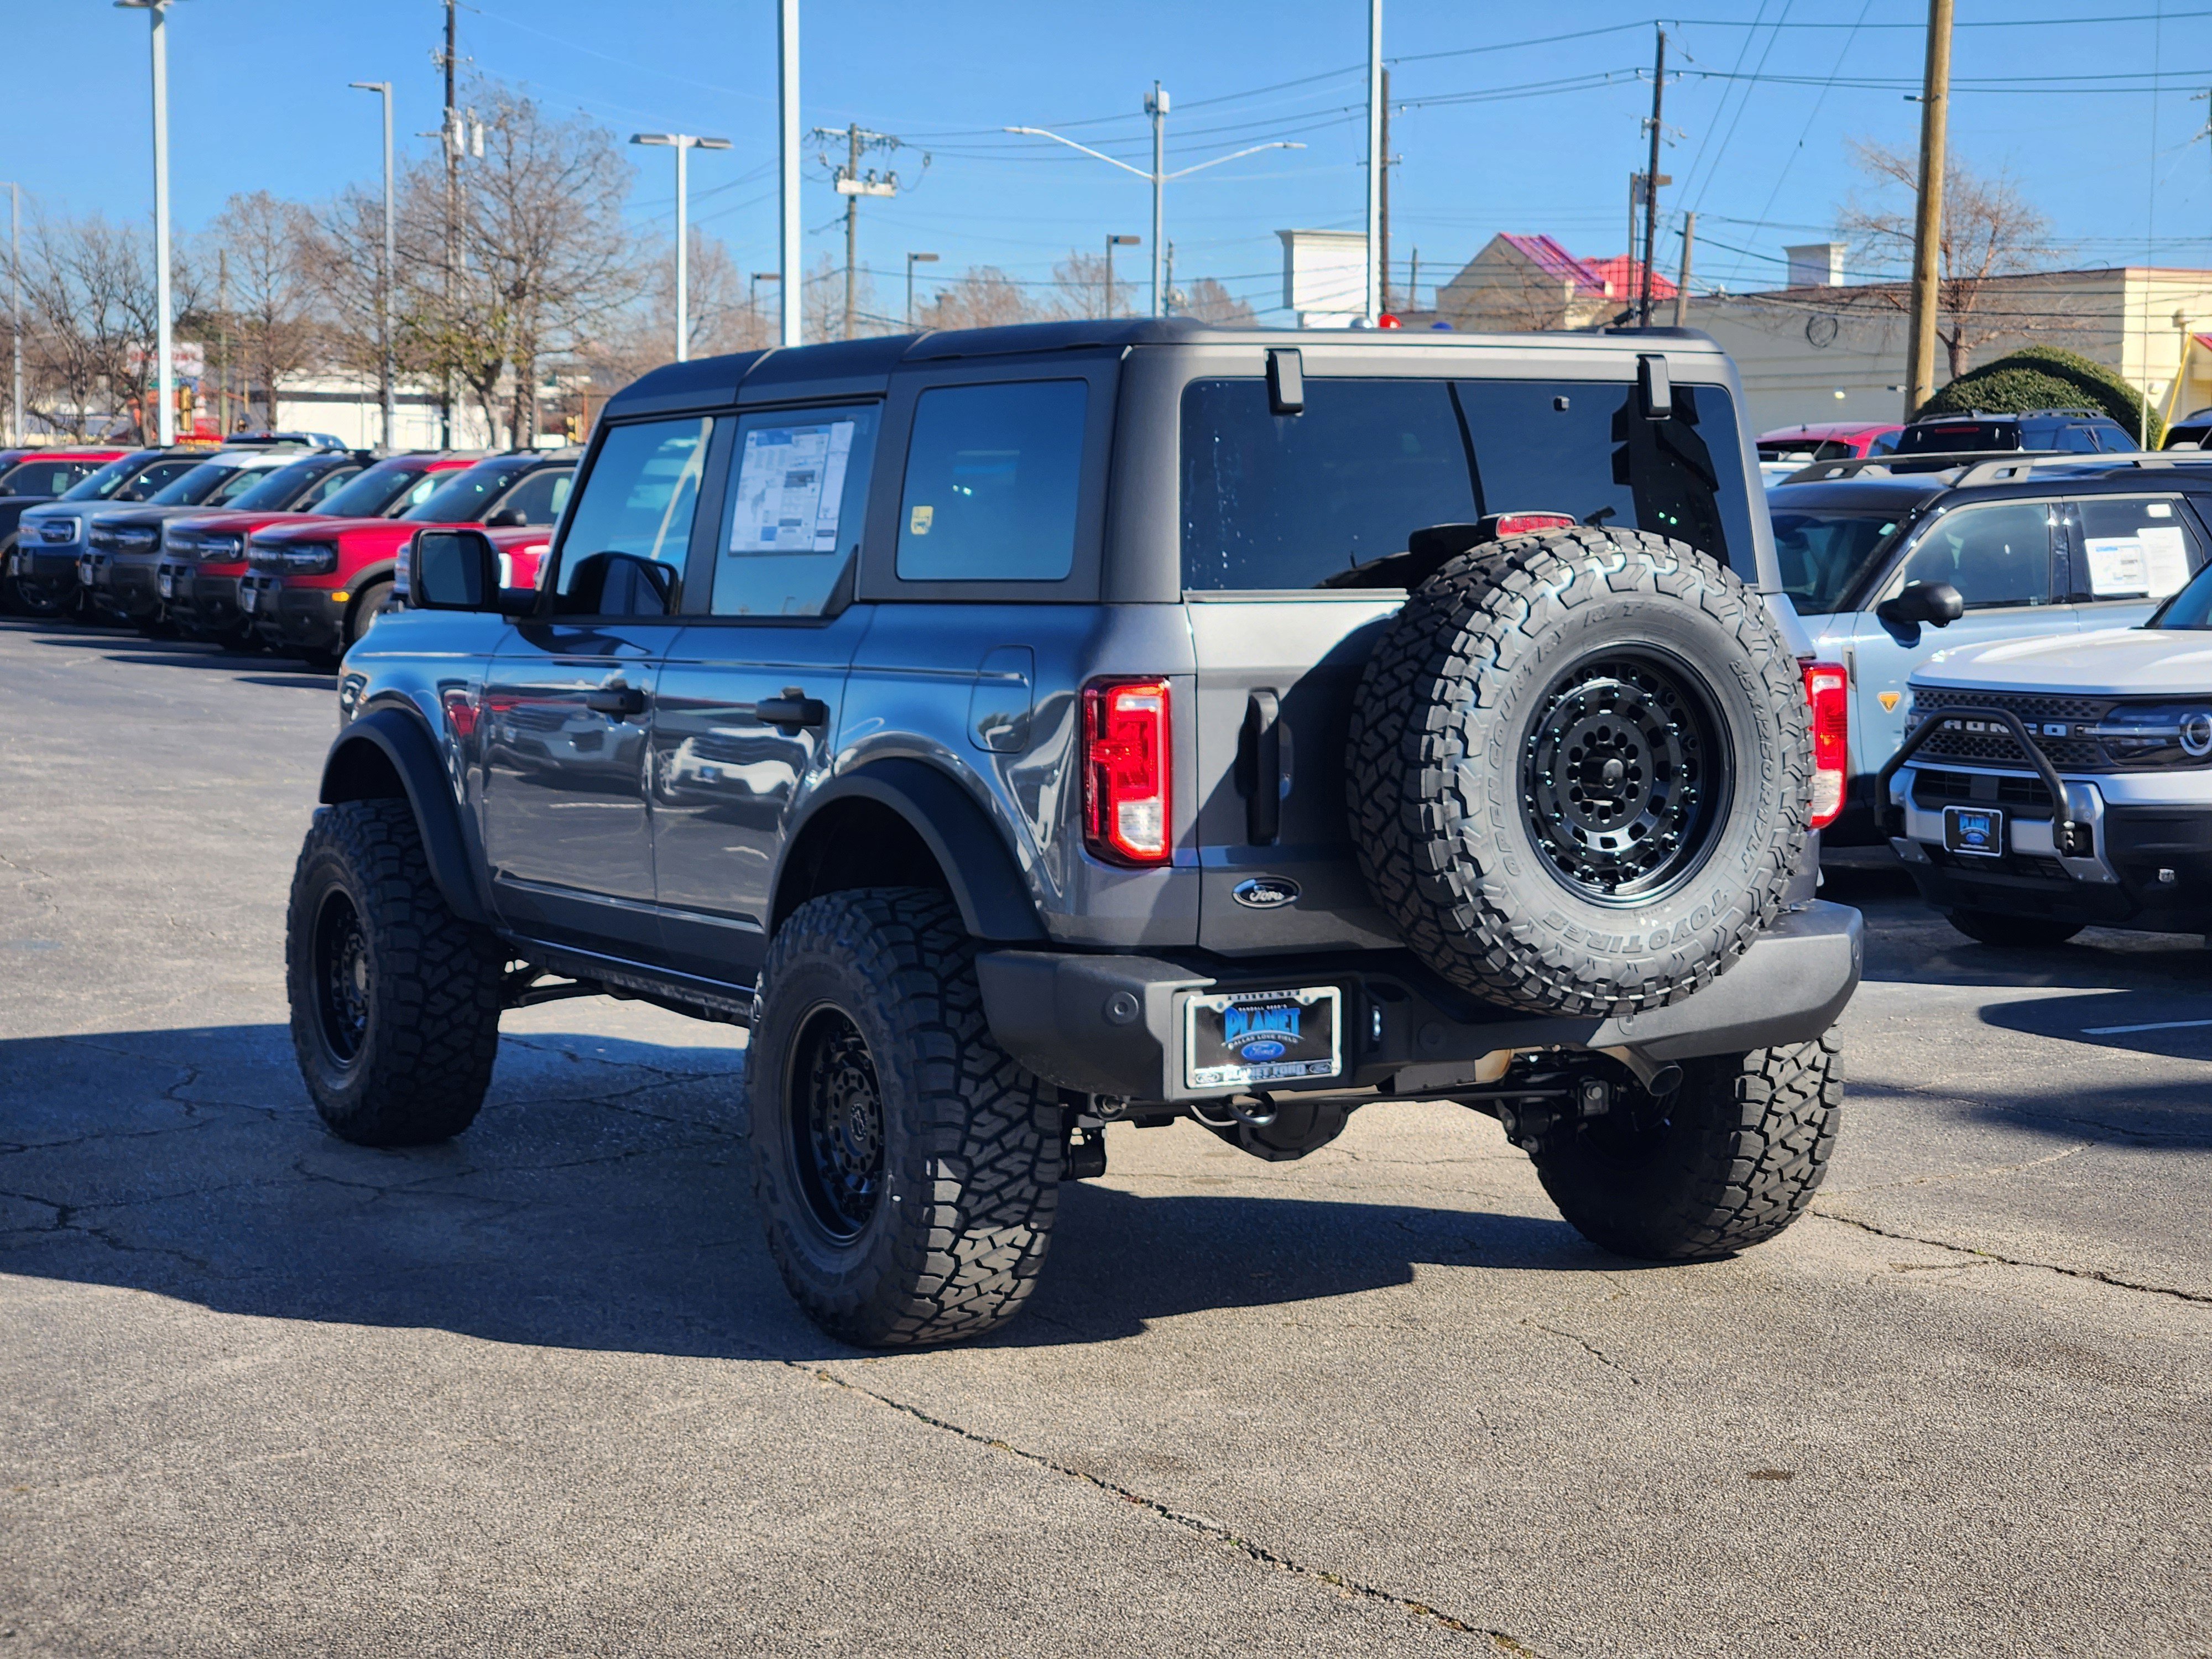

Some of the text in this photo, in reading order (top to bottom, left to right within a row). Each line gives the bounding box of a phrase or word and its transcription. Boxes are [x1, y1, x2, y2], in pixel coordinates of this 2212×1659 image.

[1488, 776, 1521, 876] OPEN
[1542, 888, 1729, 953] TOYO TIRES
[1224, 1006, 1301, 1043] PLANET
[1227, 1035, 1255, 1050] DALLAS
[1277, 1035, 1298, 1044] FIELD
[1272, 1063, 1307, 1076] FORD
